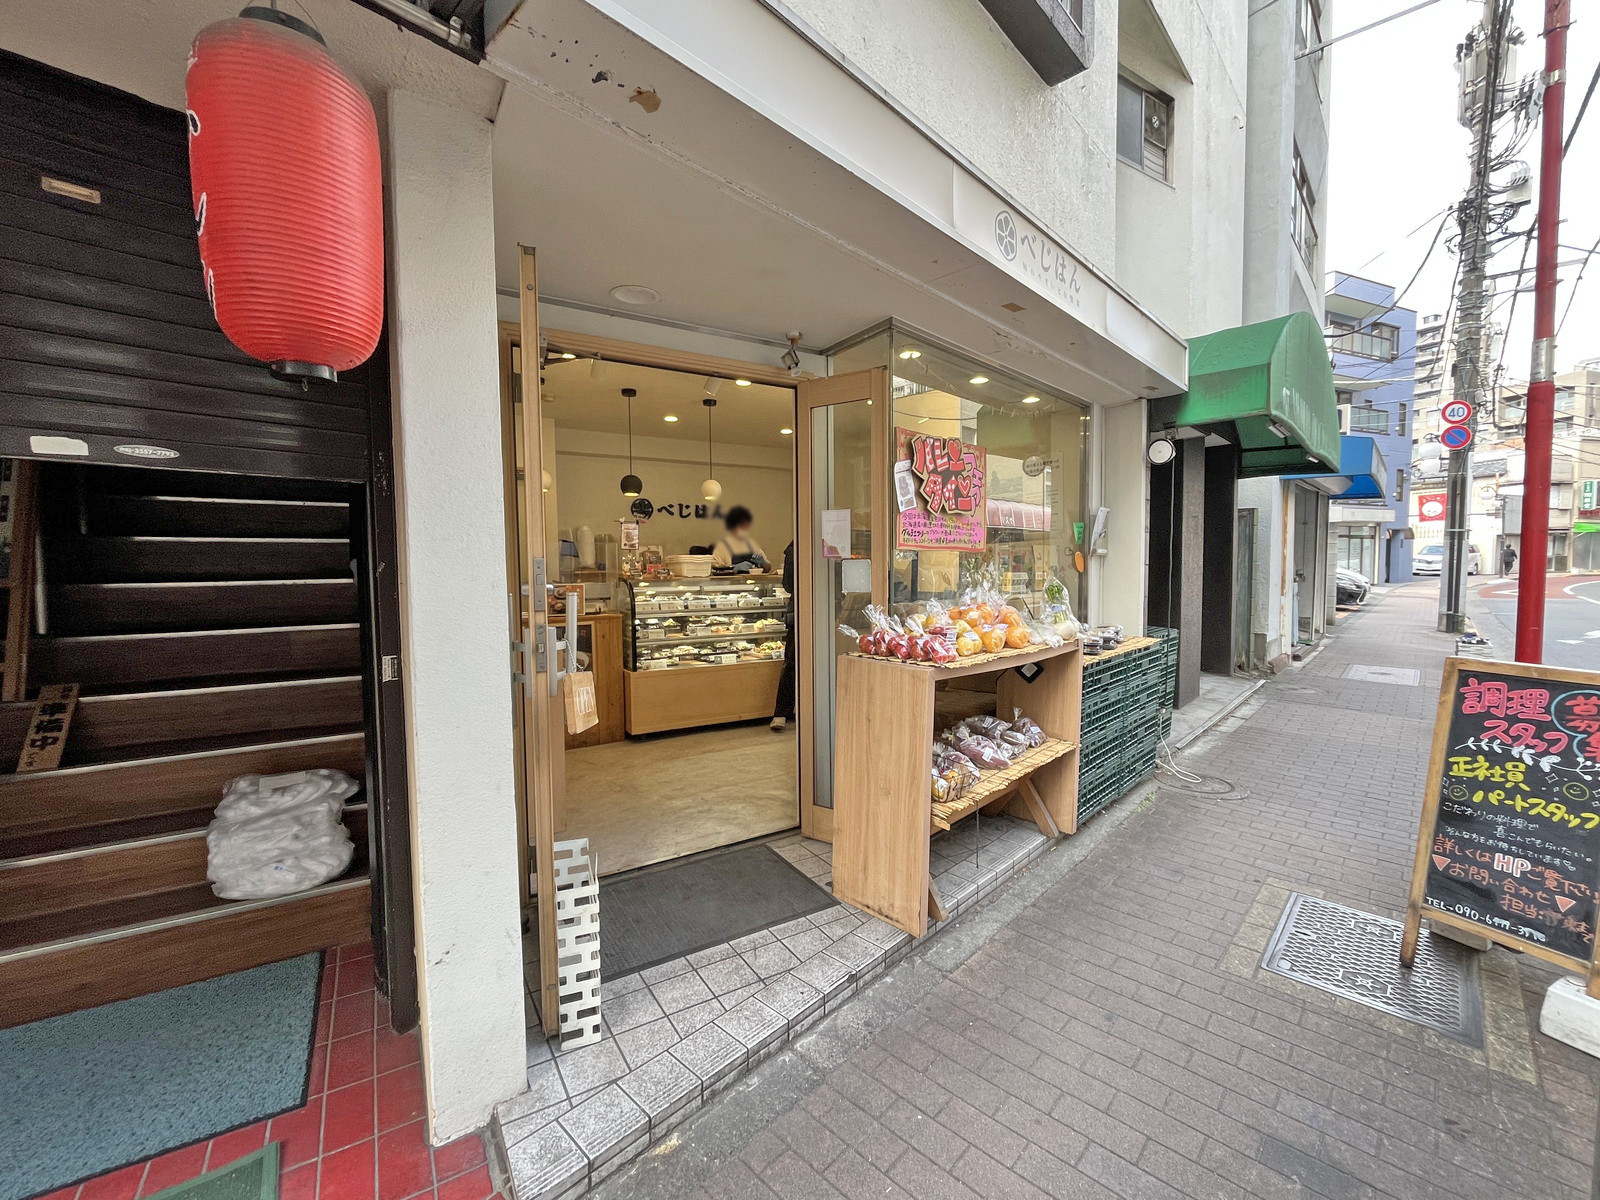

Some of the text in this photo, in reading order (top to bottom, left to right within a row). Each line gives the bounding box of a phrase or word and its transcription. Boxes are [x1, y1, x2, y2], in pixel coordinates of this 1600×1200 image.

[1020, 233, 1081, 294] べじはん
[1448, 406, 1465, 418] 40
[1460, 677, 1552, 722] 調理
[1480, 719, 1569, 754] スタッフ
[1448, 755, 1531, 792] 正社員
[1442, 802, 1539, 831] こだわりの料理で
[1472, 789, 1600, 829] パートスタッフ
[1449, 862, 1550, 905] お問い合わせ
